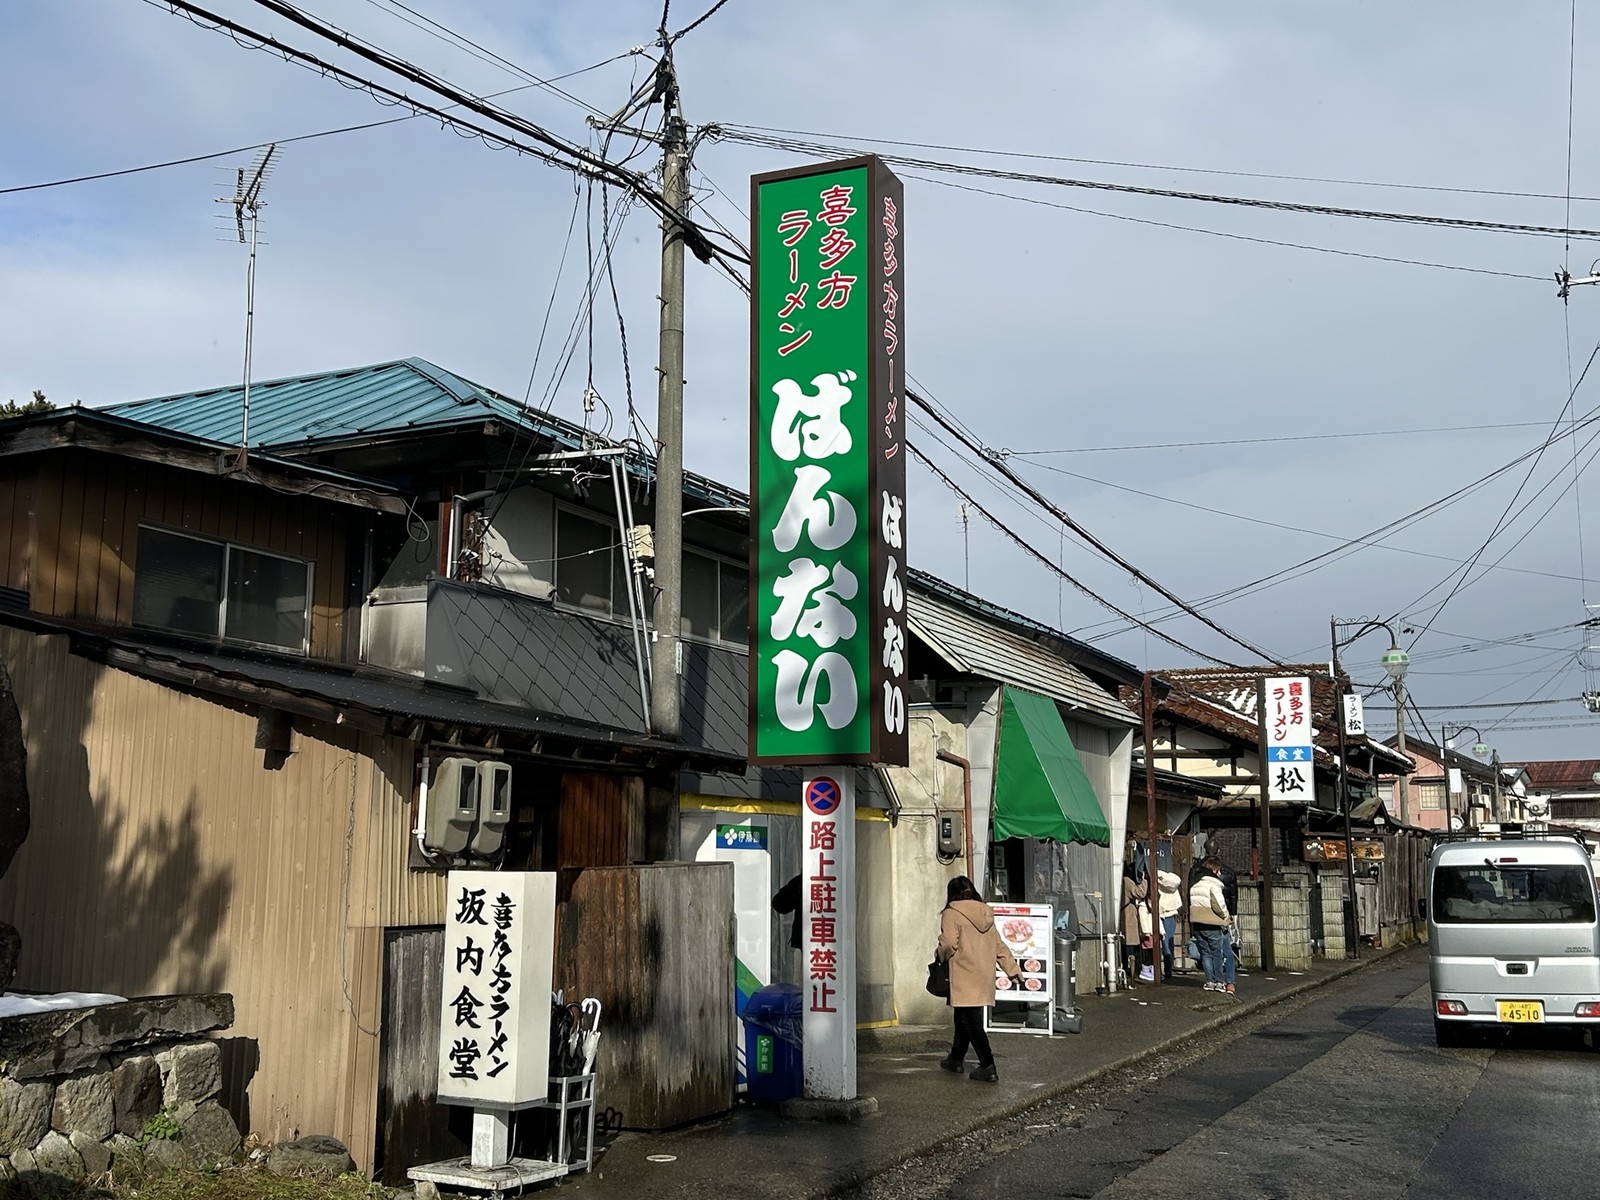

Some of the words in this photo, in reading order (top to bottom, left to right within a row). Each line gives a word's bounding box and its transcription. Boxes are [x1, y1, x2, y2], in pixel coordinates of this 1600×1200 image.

[777, 209, 812, 357] ラーメン
[816, 184, 857, 310] 喜多方
[882, 196, 899, 460] 喜多方ラーメン
[770, 369, 858, 732] ばんない
[881, 490, 905, 735] ばんない
[1273, 687, 1287, 741] ラーメン
[1276, 748, 1305, 760] 食堂
[1288, 682, 1303, 725] 喜多方
[1347, 719, 1361, 731] 松
[1275, 767, 1306, 793] 松
[449, 887, 489, 1081] 坂内食堂
[487, 892, 516, 1078] 喜多方ラーメン
[809, 820, 838, 1013] 路上駐車禁止
[1508, 1010, 1539, 1020] 45-10
